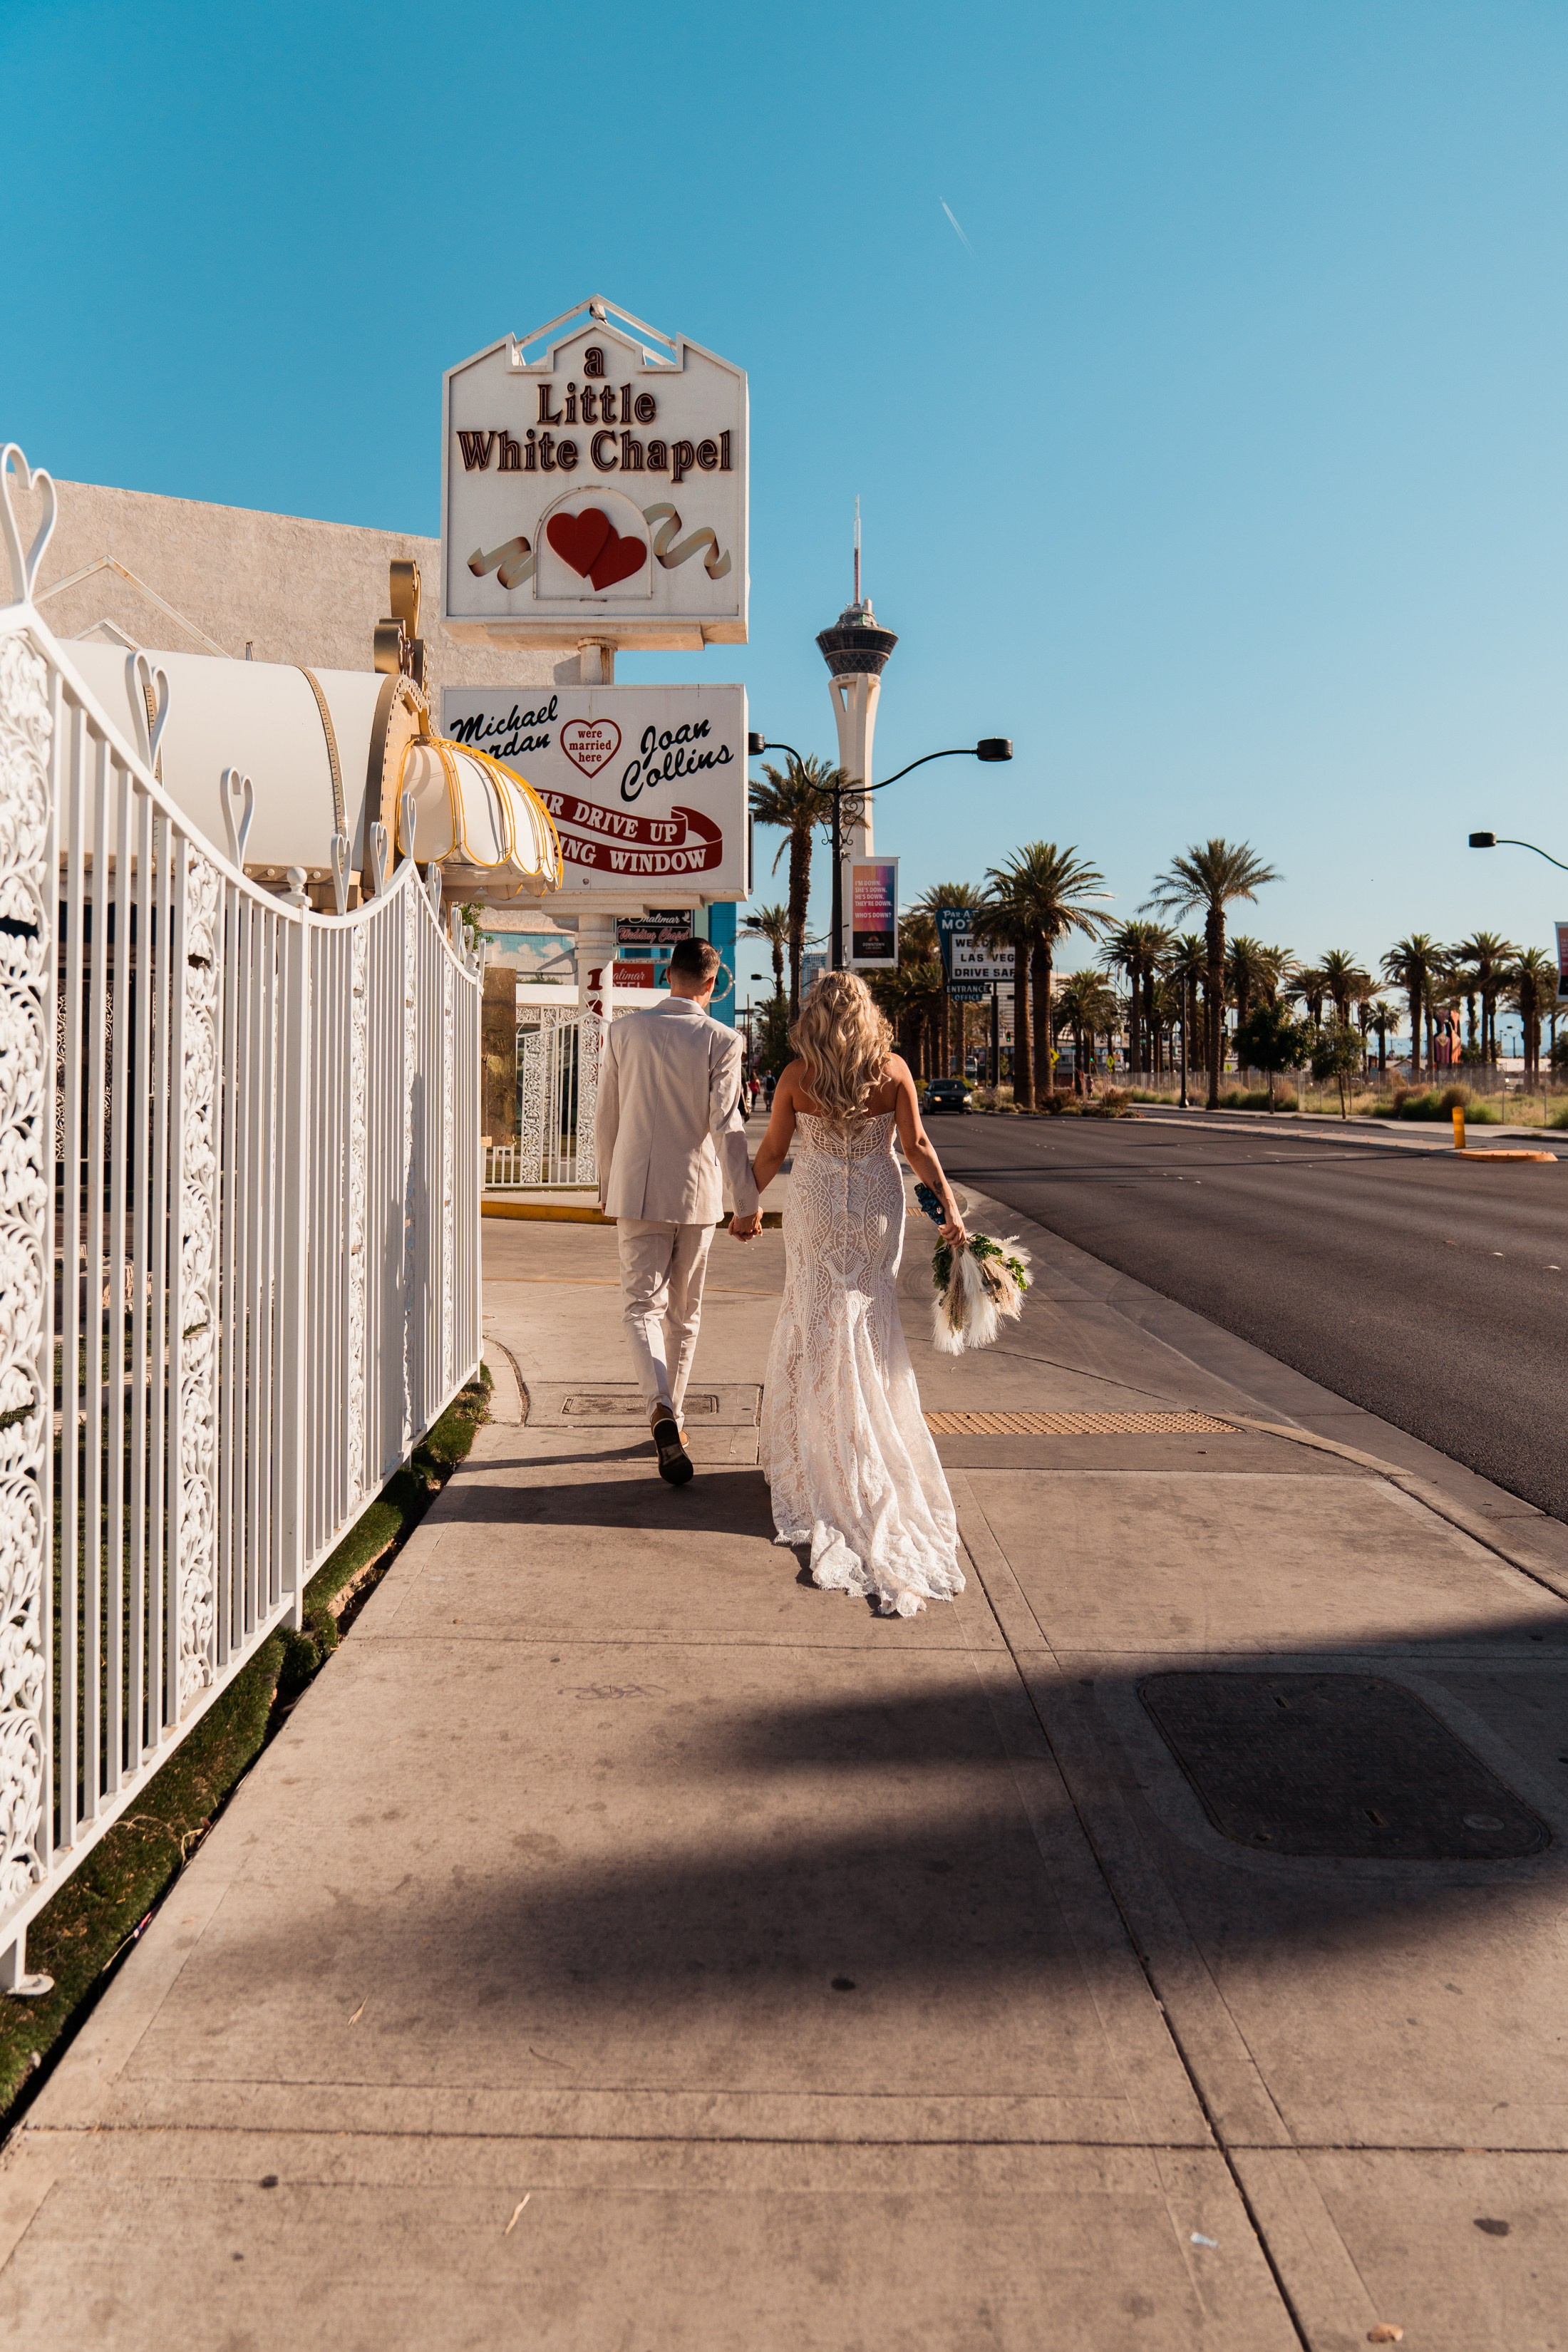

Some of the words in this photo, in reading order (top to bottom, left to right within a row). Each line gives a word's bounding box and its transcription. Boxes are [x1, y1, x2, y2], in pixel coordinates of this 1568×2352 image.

[584, 346, 605, 378] a
[536, 382, 656, 426] Little
[456, 428, 579, 472] White
[590, 428, 733, 483] Chapel
[450, 695, 558, 743] Michael
[577, 729, 602, 739] were
[569, 740, 612, 751] married
[579, 752, 602, 763] here
[640, 718, 711, 768] Joan
[620, 744, 734, 802] Collins
[572, 803, 639, 838] DRIVE
[650, 823, 678, 842] UP
[610, 848, 706, 872] WINDOW
[619, 927, 656, 944] Wedding
[659, 927, 689, 944] Chapel
[613, 969, 646, 980] alimar
